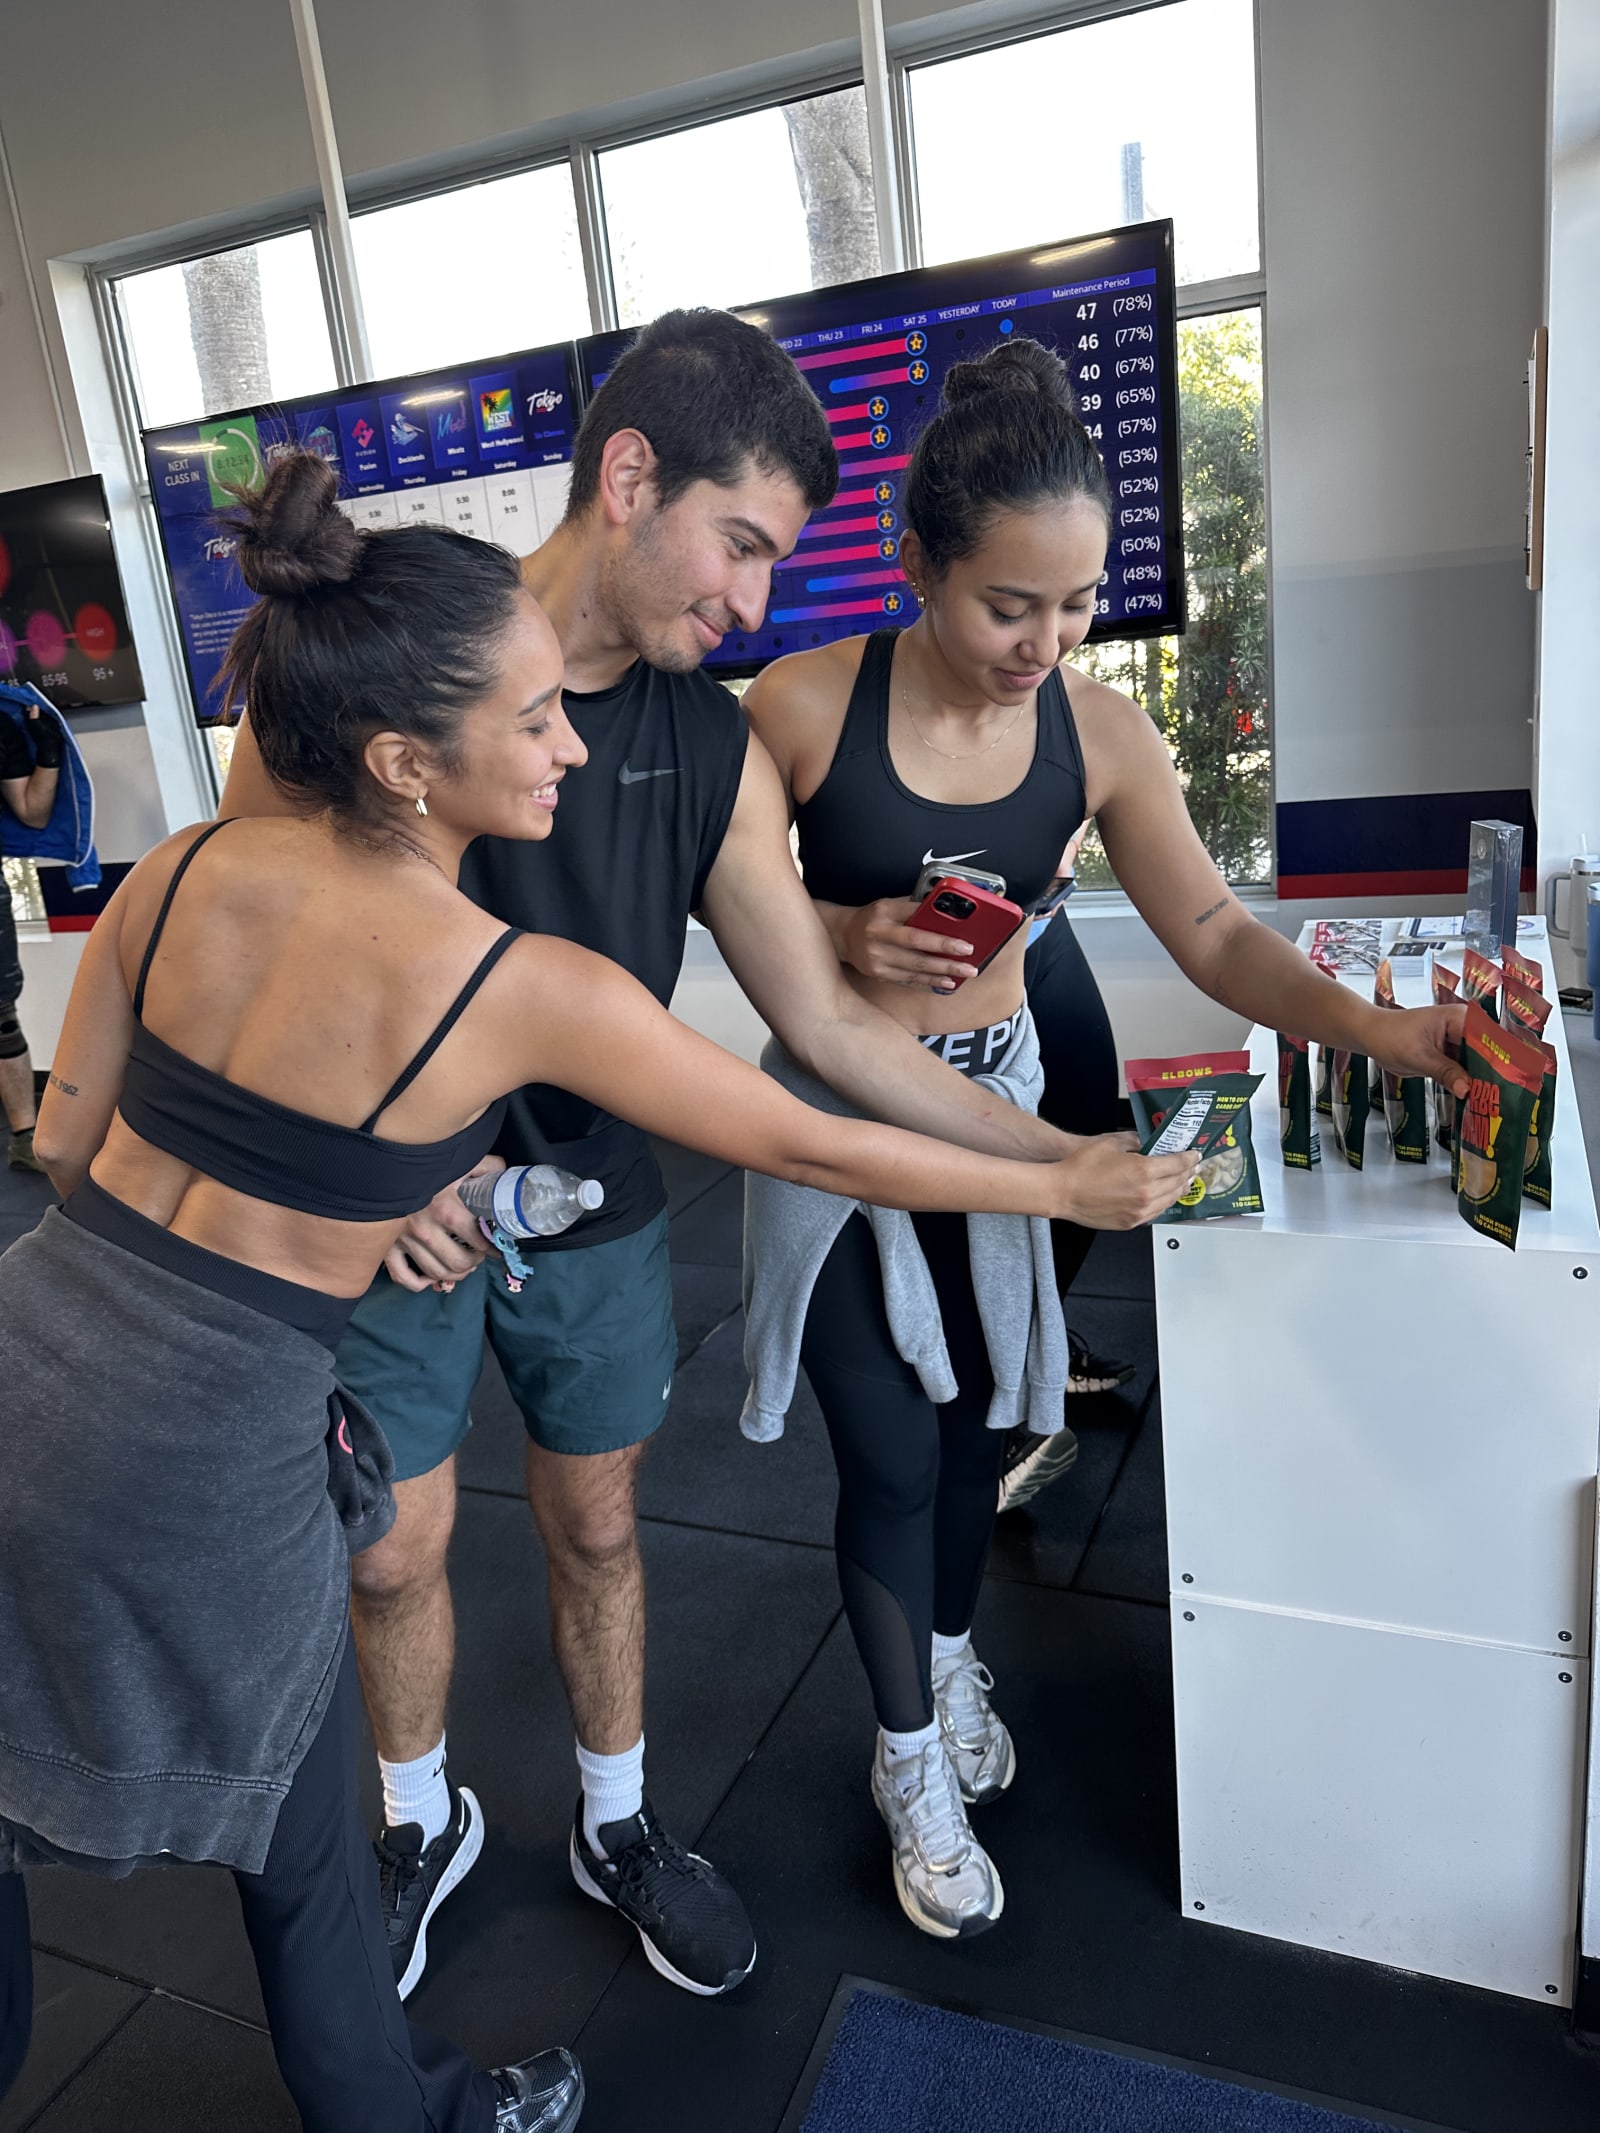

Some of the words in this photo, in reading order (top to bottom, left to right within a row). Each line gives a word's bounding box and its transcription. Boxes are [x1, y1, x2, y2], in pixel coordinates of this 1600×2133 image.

[1052, 284, 1102, 299] Maintenance
[1103, 277, 1131, 289] Period
[938, 304, 980, 320] YESTERDAY
[992, 298, 1017, 310] TODAY
[1076, 302, 1097, 321] 47
[1113, 293, 1152, 317] (78%)
[861, 325, 872, 335] FRI
[872, 323, 883, 333] 24
[903, 316, 916, 327] SAT
[916, 314, 928, 324] 25
[794, 338, 803, 348] 22
[817, 332, 833, 343] THU
[834, 330, 844, 340] 23
[1078, 333, 1099, 351] 46
[1115, 324, 1153, 348] (77%)
[1079, 363, 1100, 381] 40
[1115, 355, 1154, 378] (67%)
[1081, 394, 1102, 412] 39
[1115, 385, 1156, 409] (65%)
[1118, 416, 1157, 438] (57%)
[168, 458, 189, 472] NEXT
[1118, 446, 1158, 468] (53%)
[165, 473, 190, 487] CLASS
[191, 471, 200, 482] IN
[1119, 476, 1159, 498] (52%)
[1120, 506, 1160, 527] (52%)
[1121, 535, 1161, 556] (50%)
[1122, 564, 1162, 585] (48%)
[1124, 593, 1163, 614] (47%)
[1481, 1033, 1511, 1065] ELBOWS
[1161, 1066, 1213, 1080] ELBOWS
